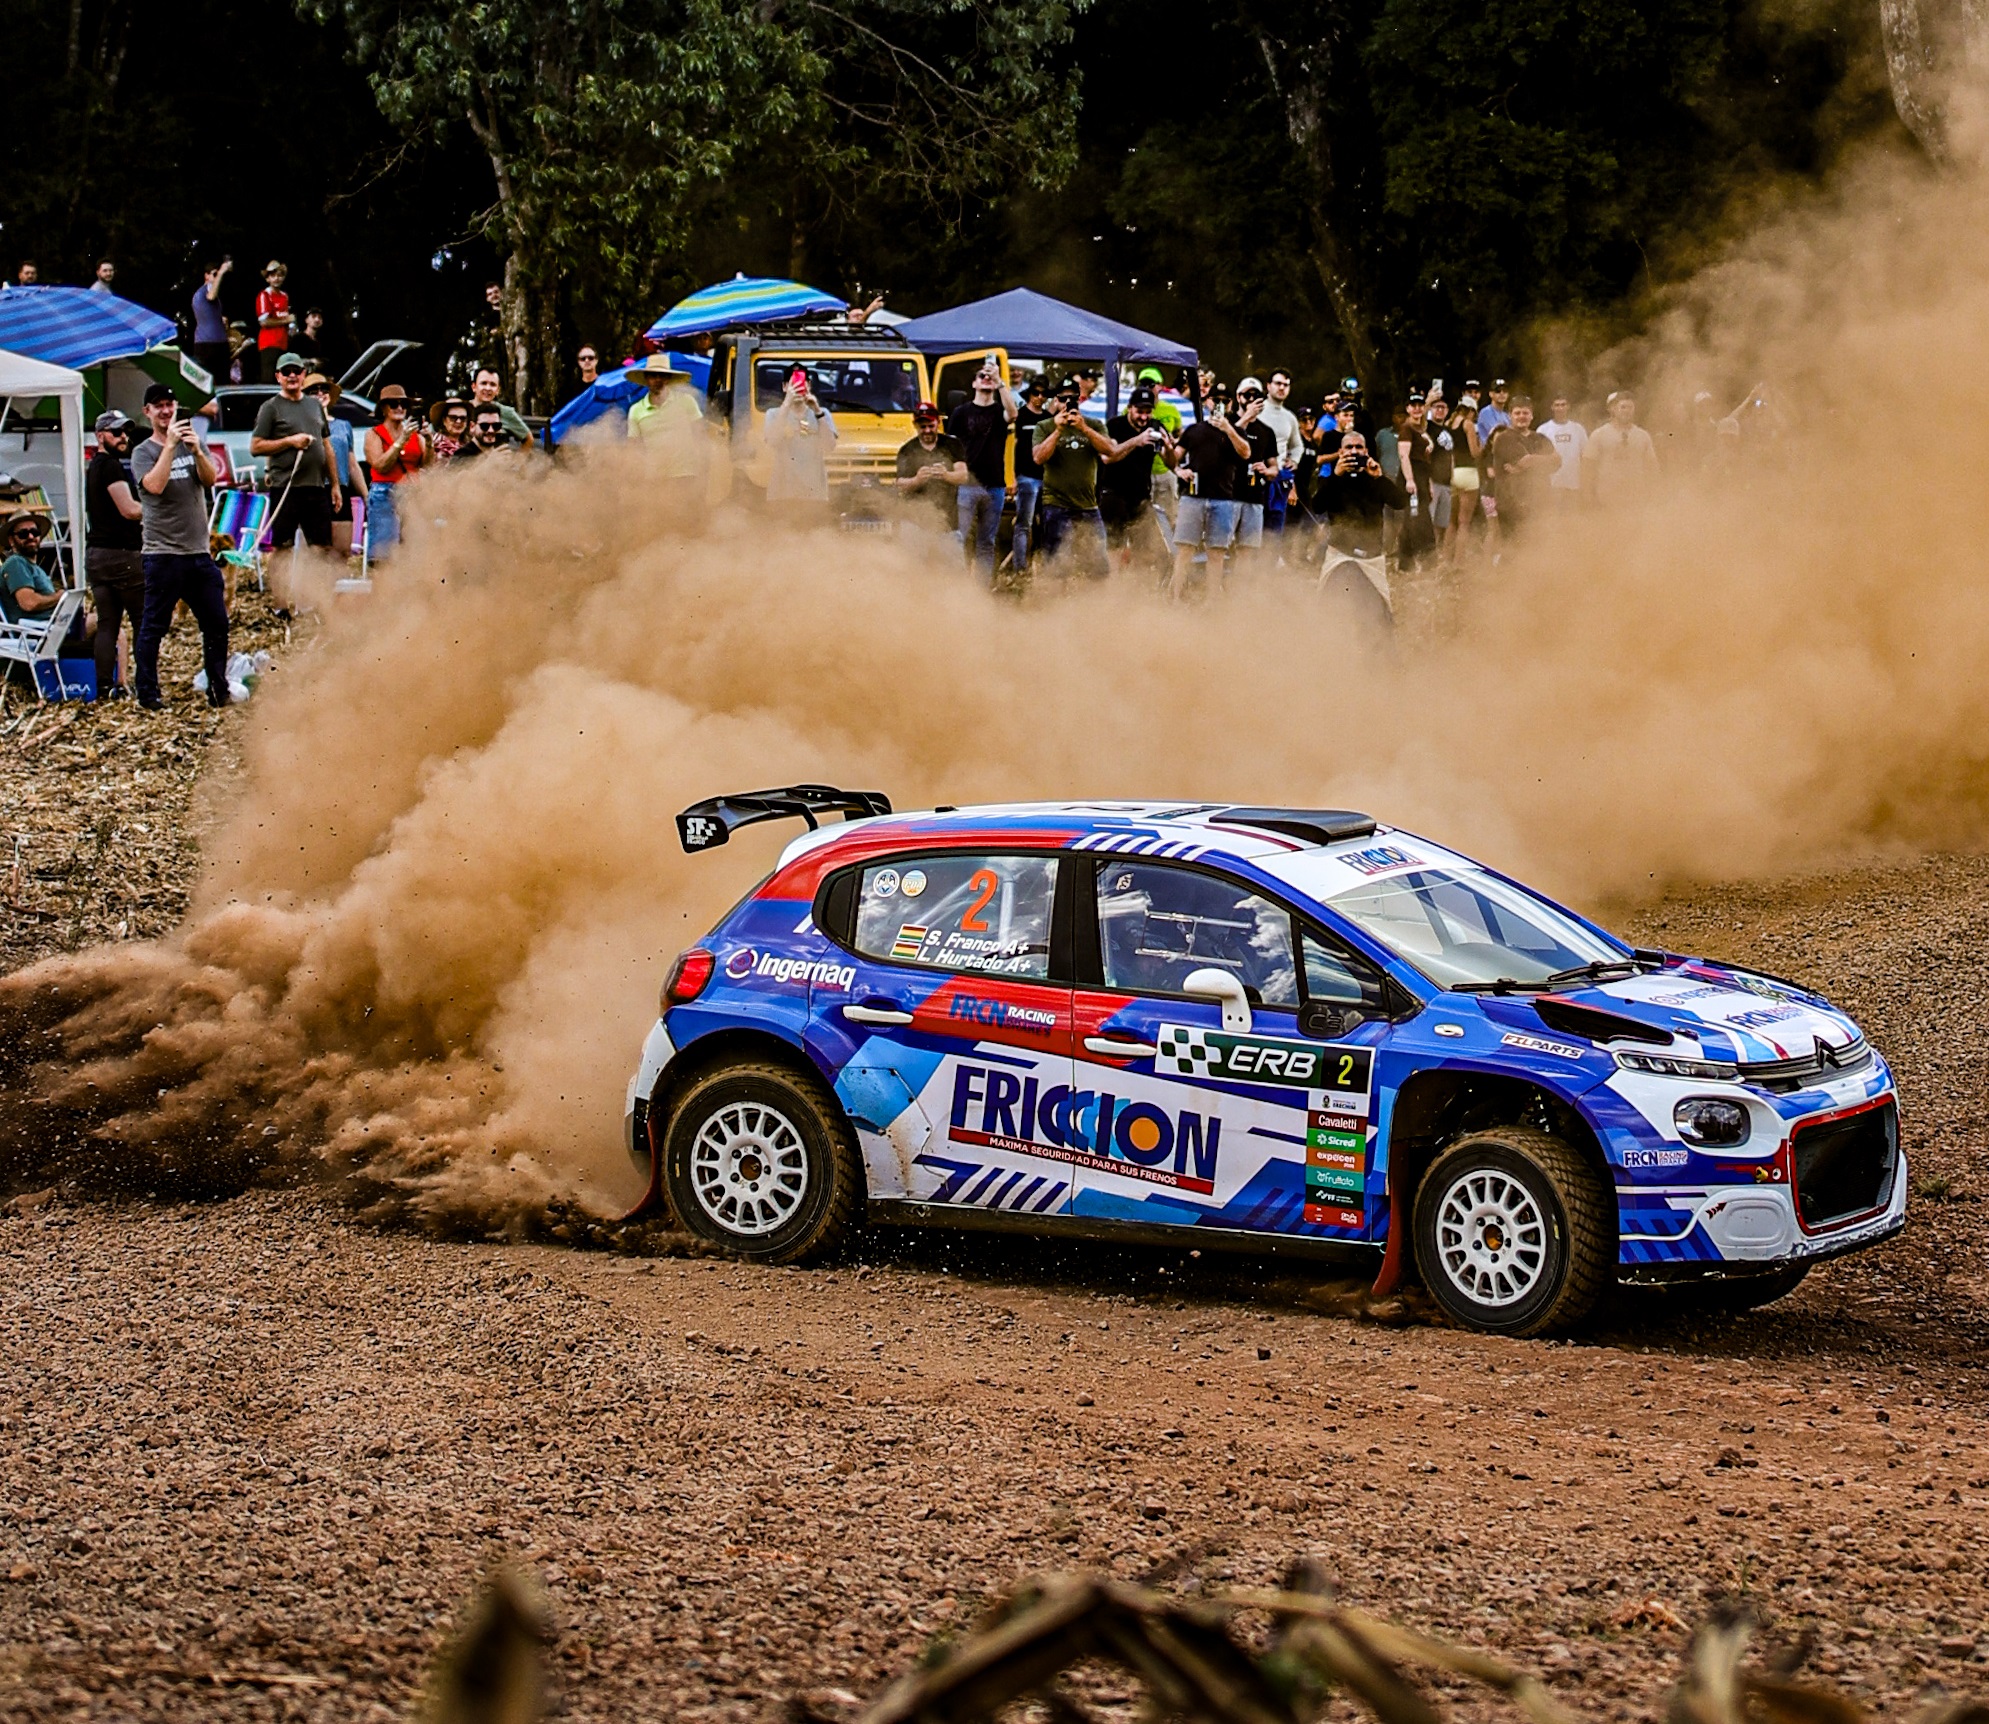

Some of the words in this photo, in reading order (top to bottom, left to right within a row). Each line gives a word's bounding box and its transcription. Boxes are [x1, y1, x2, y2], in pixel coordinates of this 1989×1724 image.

[960, 868, 999, 932] 2
[926, 930, 942, 946] S.
[944, 932, 1001, 953] Franco
[1002, 939, 1030, 955] A+
[917, 946, 931, 962] L.
[934, 948, 1004, 970] Hurtado
[1004, 957, 1031, 973] A+
[949, 993, 1008, 1028] FRCN
[1007, 1006, 1056, 1025] RACING
[1504, 1034, 1580, 1057] FILPARTS
[1228, 1045, 1316, 1078] ERB
[1337, 1055, 1354, 1085] 2
[1318, 1114, 1357, 1130] Cavaletti
[1328, 1136, 1356, 1147] Sicredi
[990, 1137, 1028, 1152] MAXIMA
[1091, 1159, 1118, 1172] PARA
[1120, 1165, 1138, 1176] SUS
[1140, 1169, 1177, 1185] FRENOS
[1624, 1151, 1659, 1166] FRCN
